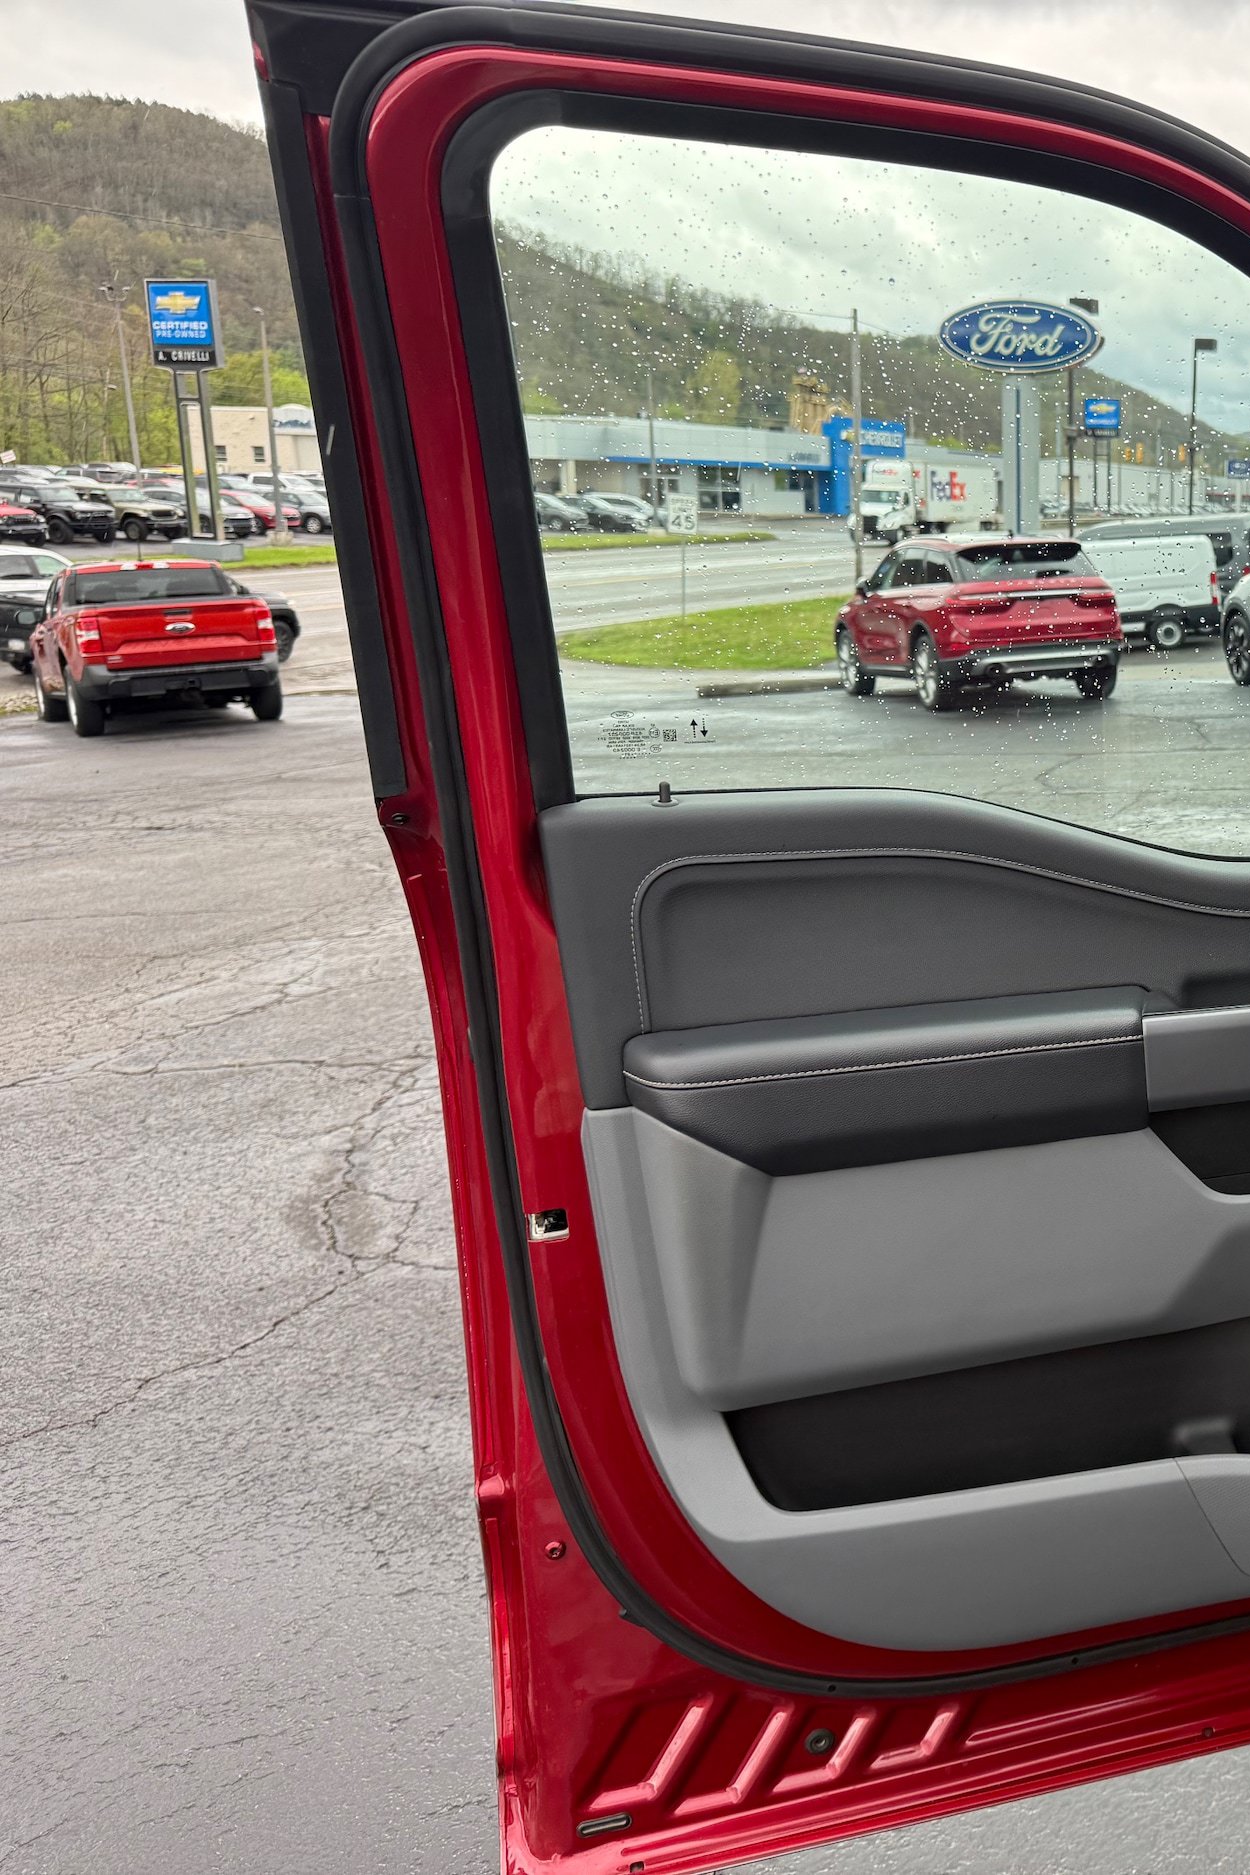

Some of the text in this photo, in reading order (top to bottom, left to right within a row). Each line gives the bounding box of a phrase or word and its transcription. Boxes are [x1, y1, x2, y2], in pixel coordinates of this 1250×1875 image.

[152, 321, 208, 330] CERTIFIED
[969, 313, 1066, 357] Ford
[930, 470, 966, 501] FedEx
[671, 515, 695, 530] 45
